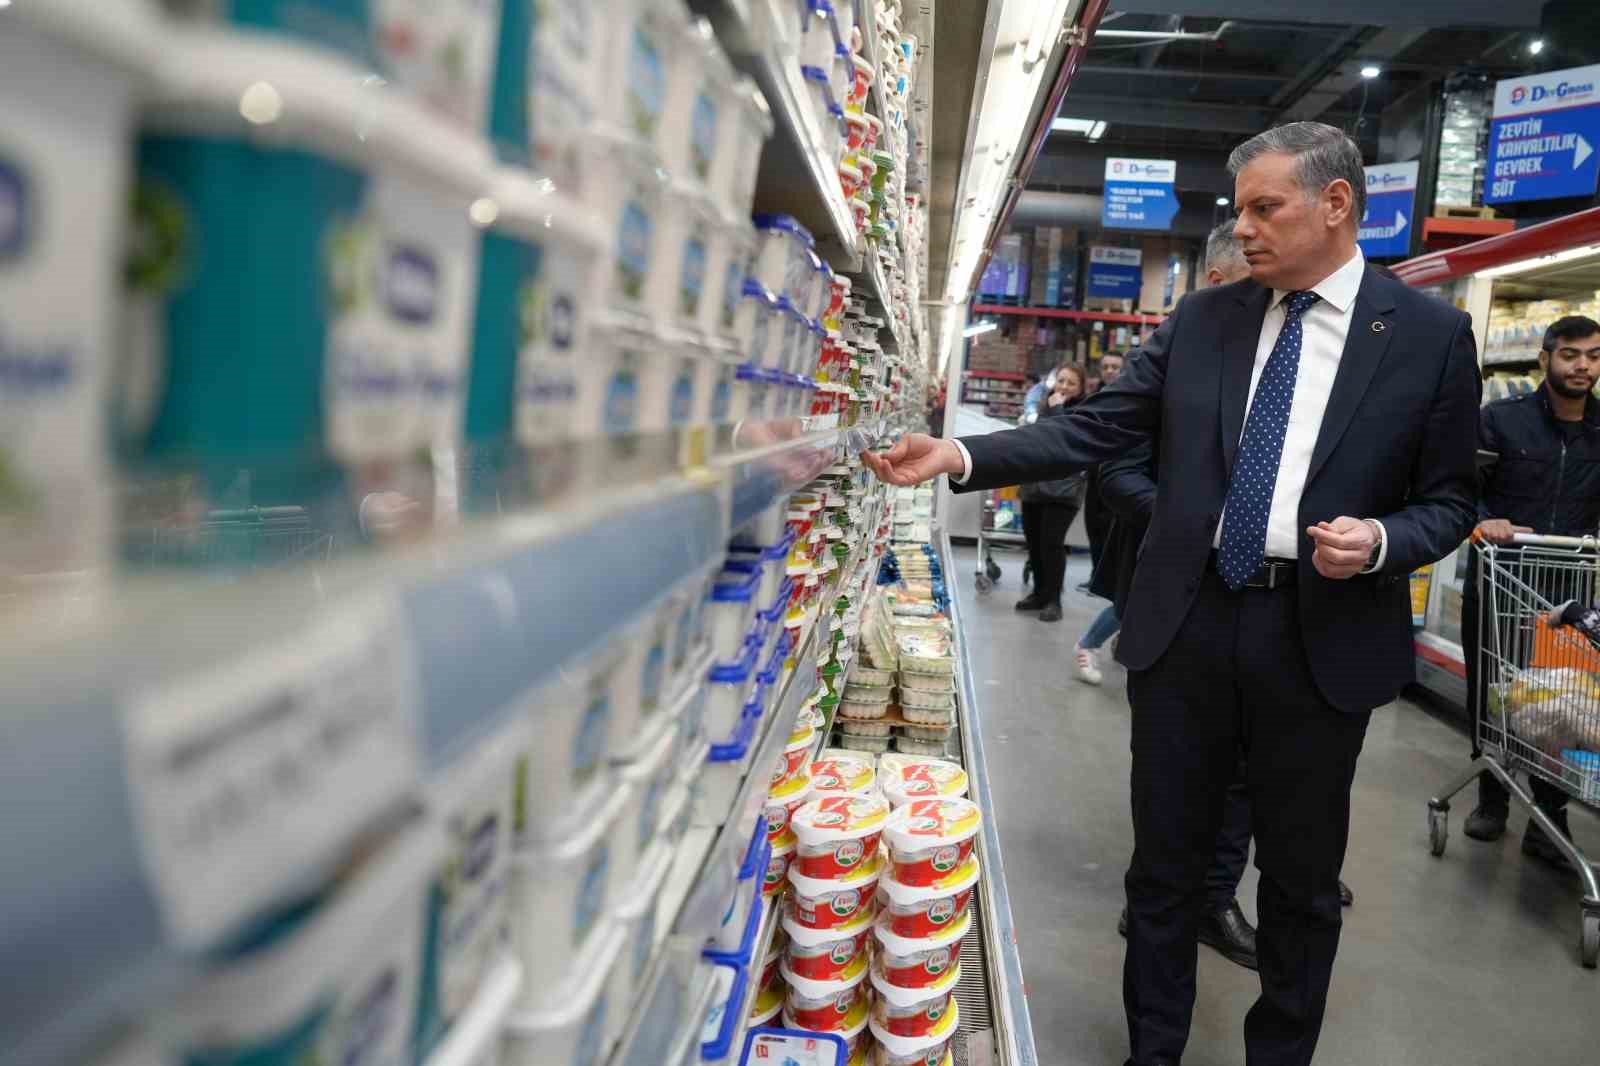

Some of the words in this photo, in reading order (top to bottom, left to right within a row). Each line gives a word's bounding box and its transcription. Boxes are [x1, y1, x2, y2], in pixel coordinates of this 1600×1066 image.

[1497, 133, 1578, 159] KAHVALTILIK
[1495, 157, 1543, 177] GEVREK
[1491, 179, 1516, 198] SÜT
